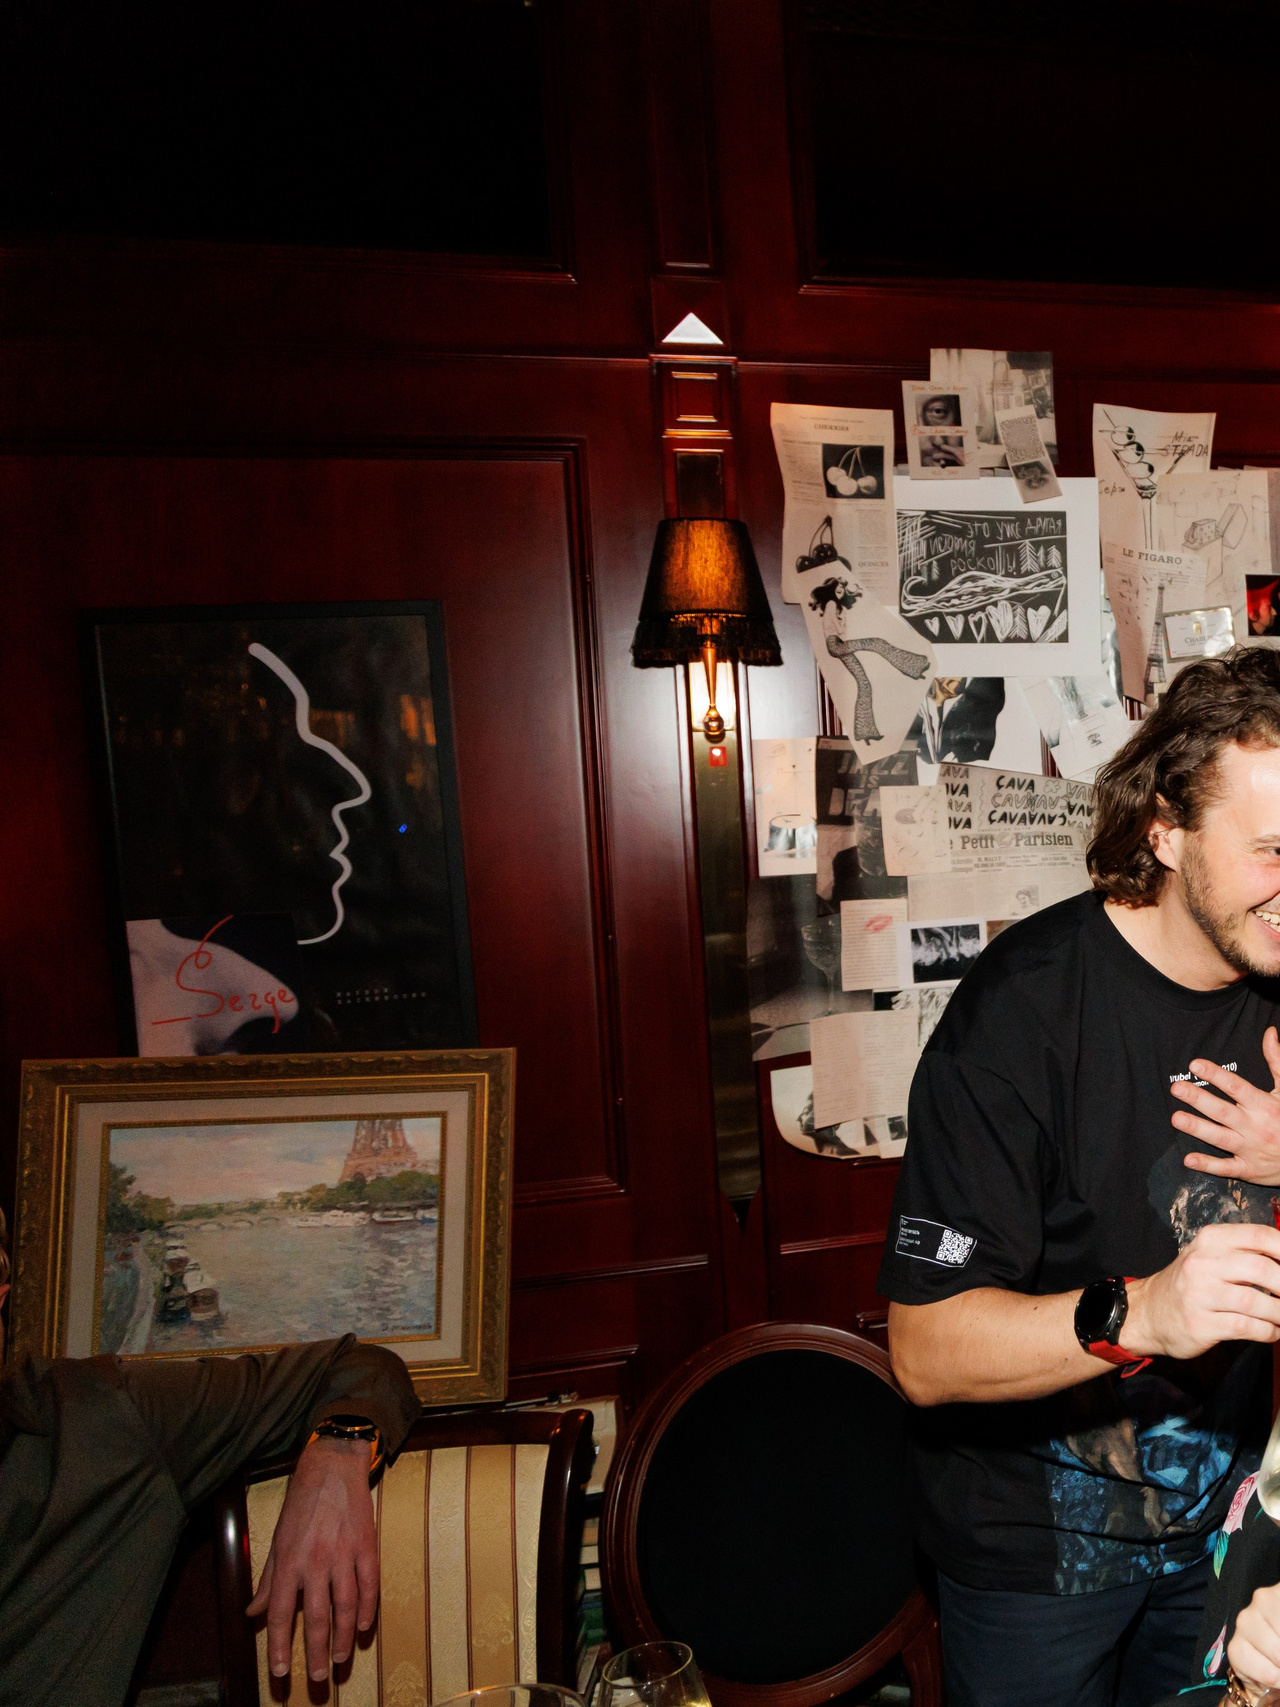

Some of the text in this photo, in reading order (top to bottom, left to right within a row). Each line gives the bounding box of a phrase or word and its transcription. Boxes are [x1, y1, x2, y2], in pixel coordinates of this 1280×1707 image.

[1161, 444, 1209, 458] STRADA
[1122, 548, 1182, 565] LE FIGARO
[828, 787, 881, 817] DEA
[961, 831, 1074, 849] Petit Parisien
[152, 914, 296, 1034] Serge
